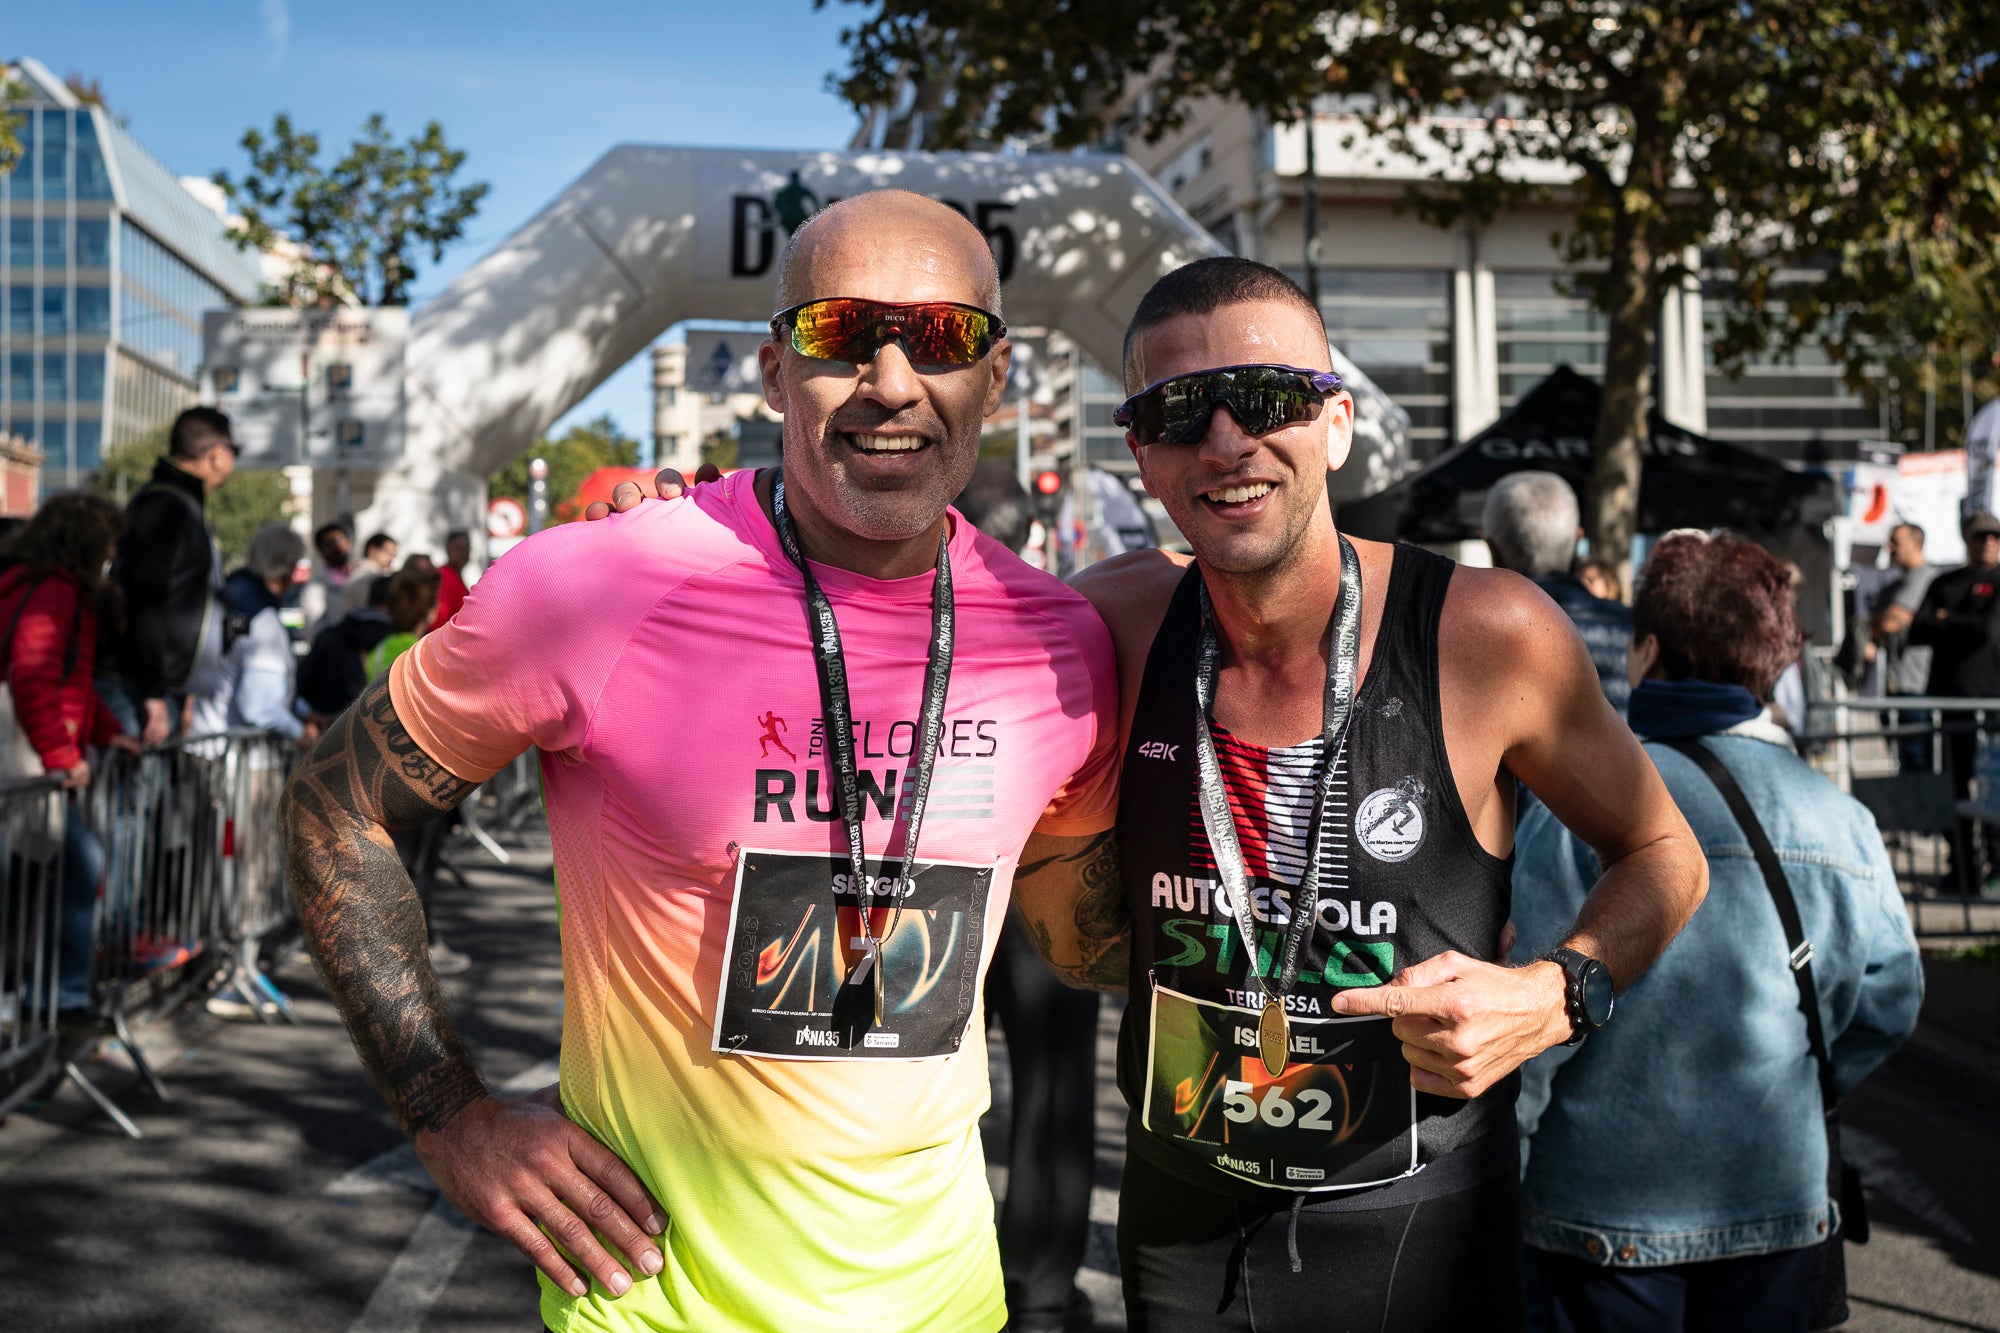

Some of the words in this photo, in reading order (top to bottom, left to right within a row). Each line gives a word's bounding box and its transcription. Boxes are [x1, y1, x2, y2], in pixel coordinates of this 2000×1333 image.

[885, 314, 906, 322] DUCO
[1480, 437, 1698, 459] GARIN
[808, 717, 825, 759] TONI
[1138, 740, 1180, 762] 42K
[841, 753, 850, 774] Pau
[754, 769, 897, 822] RUN
[832, 872, 916, 899] SERGIO
[969, 878, 987, 929] PAU
[1152, 872, 1397, 935] AUTOESOLA
[1299, 909, 1309, 929] Pau
[735, 915, 759, 989] 2026
[1154, 918, 1395, 987] STILO
[1225, 988, 1321, 1015] TERRSSA
[1234, 1026, 1325, 1055] ISEL
[1223, 1080, 1333, 1131] 562
